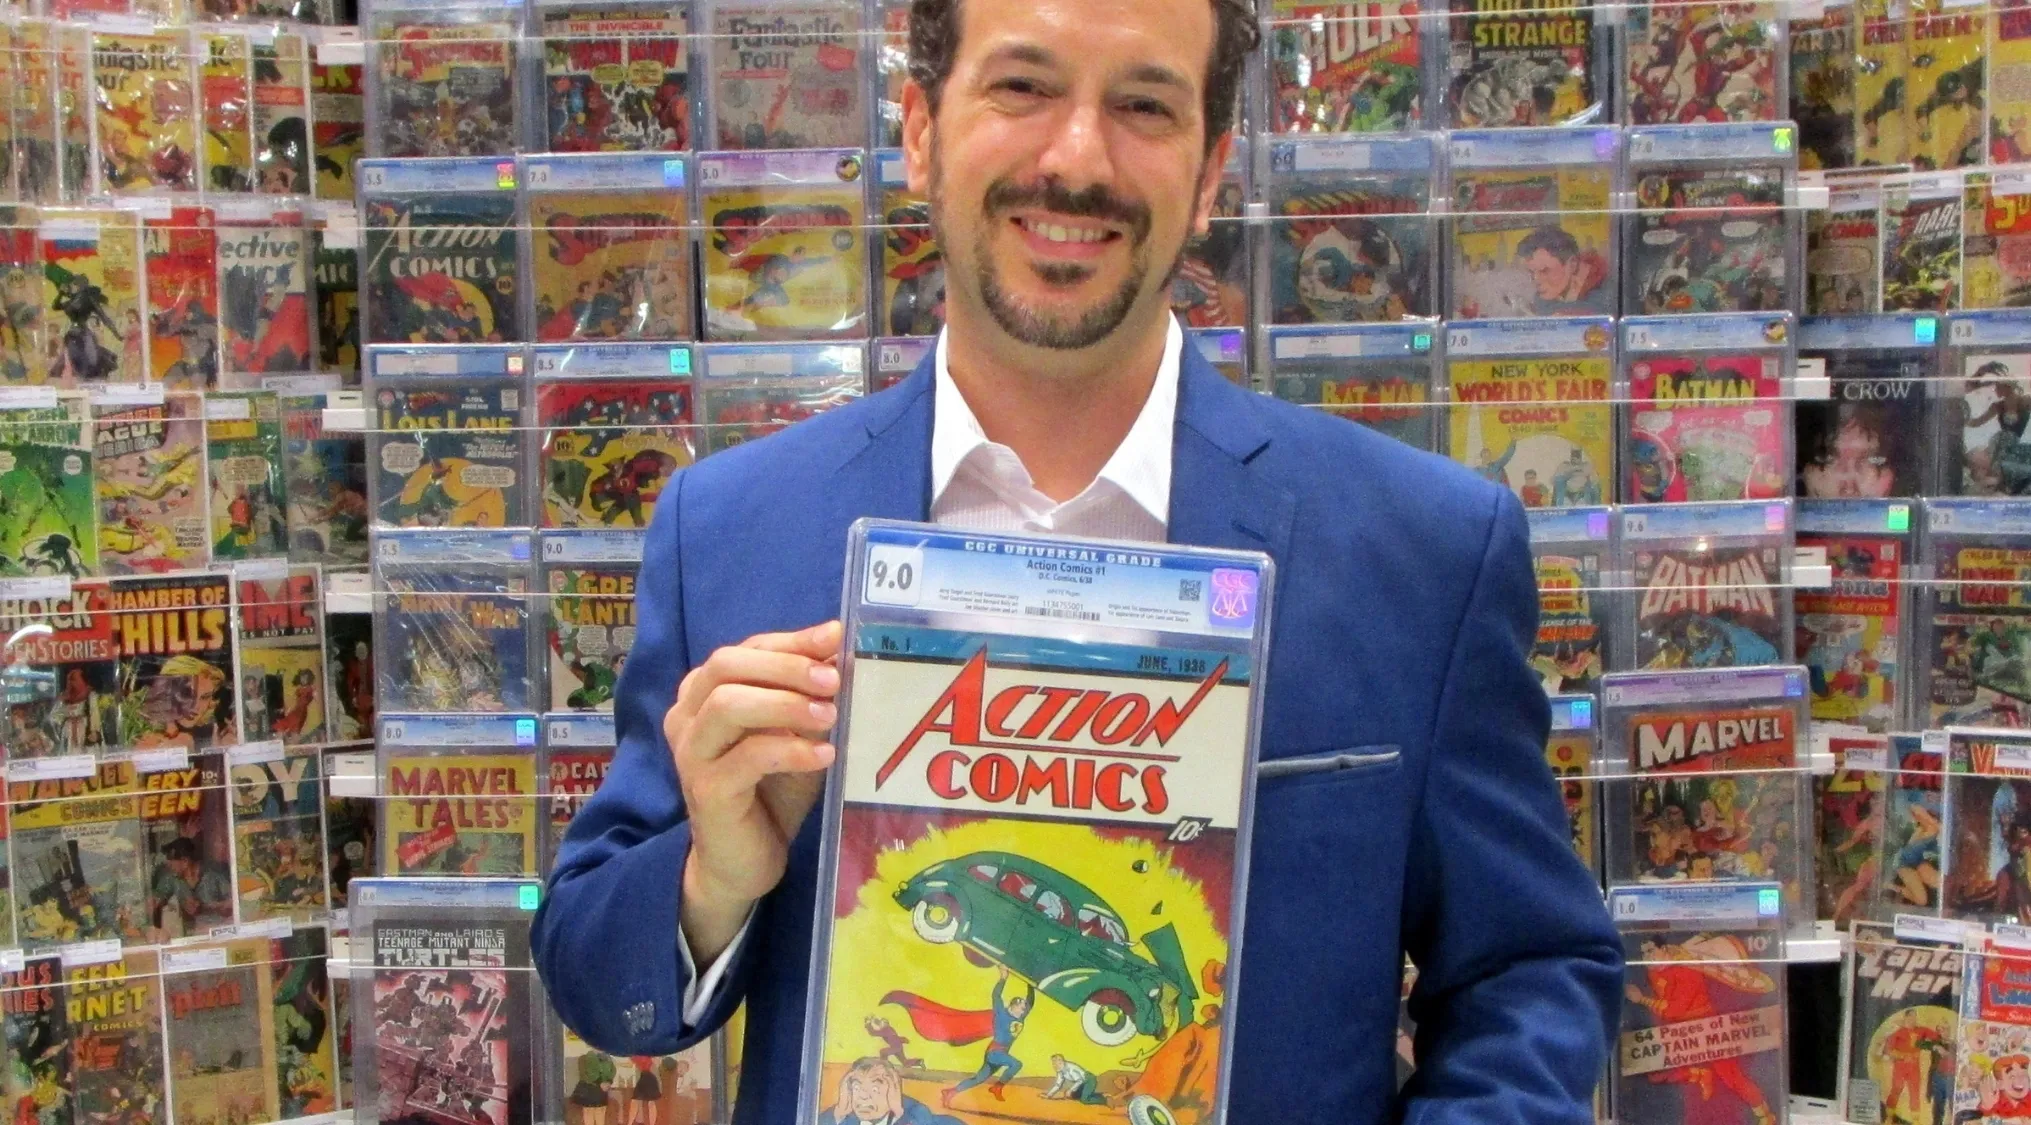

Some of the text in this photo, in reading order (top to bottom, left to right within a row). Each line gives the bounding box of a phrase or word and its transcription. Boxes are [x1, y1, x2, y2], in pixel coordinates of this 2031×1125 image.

[569, 22, 664, 31] THE INVINCIBLE
[729, 16, 845, 49] Fantastic
[1303, 0, 1412, 72] HULK
[1474, 20, 1586, 47] STRANGE
[739, 51, 793, 69] Four
[702, 168, 719, 180] 5.0
[367, 209, 515, 273] ACTION
[390, 256, 498, 279] COMICS
[1452, 335, 1468, 346] 7.0
[1492, 363, 1584, 378] NEW YORK
[1456, 379, 1607, 402] WORLD'S FAIR
[1654, 373, 1756, 410] BATMAN
[1844, 381, 1911, 399] CROW
[383, 410, 442, 432] LOIS
[447, 410, 513, 433] LANE
[1498, 407, 1569, 424] COMICS
[964, 541, 1161, 567] CGC UNIVERSAL GRADE
[872, 560, 913, 590] 9.0
[1027, 559, 1106, 576] Action Comics #1
[201, 586, 225, 606] OF
[1640, 553, 1774, 620] BATMAN
[263, 630, 285, 639] NOT
[294, 628, 314, 637] PAY
[881, 635, 899, 651] No.
[1137, 654, 1206, 674] JUNE, 1938
[875, 643, 1229, 793] ACTION
[552, 727, 568, 739] 8.5
[1637, 717, 1784, 769] MARVEL
[147, 768, 199, 791] ERY
[391, 766, 524, 796] MARVEL
[926, 750, 1171, 816] COMICS
[142, 791, 200, 818] EEN
[408, 798, 509, 828] TALES
[378, 929, 432, 937] EASTMAN
[378, 938, 506, 948] TEENAGE MUTANT NINJA
[378, 949, 506, 967] TURTLES
[71, 961, 127, 995] EEN
[94, 1019, 145, 1032] COMICS
[1635, 1012, 1761, 1043] 64 Pages of New
[1631, 1025, 1771, 1060] CAPTAIN MARVEL
[1663, 1045, 1744, 1067] Adventures
